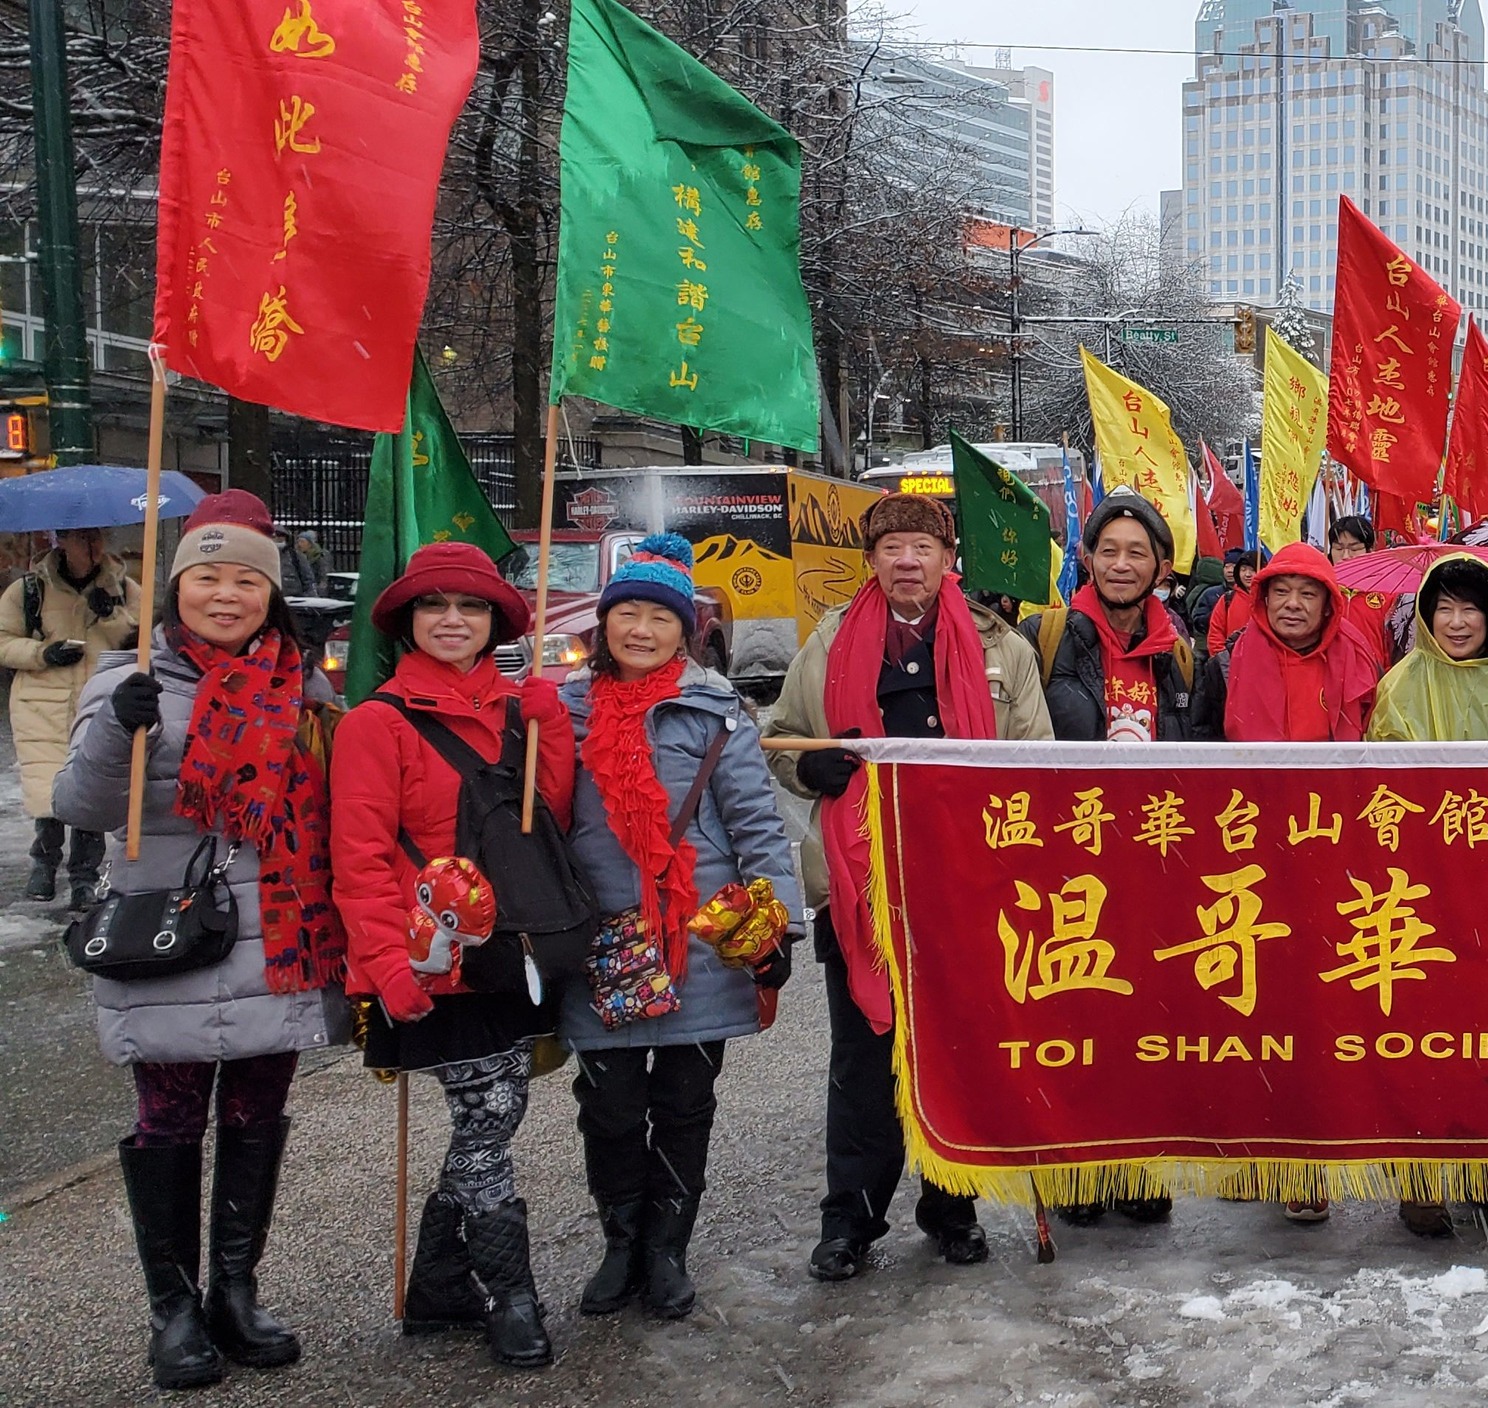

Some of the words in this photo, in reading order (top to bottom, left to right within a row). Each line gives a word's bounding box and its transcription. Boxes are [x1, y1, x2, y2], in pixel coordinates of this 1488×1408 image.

[1125, 330, 1160, 342] Beatty
[1164, 331, 1176, 341] St
[900, 477, 954, 493] SPECIAL
[671, 504, 783, 514] HARLEY-DAVIDSON
[998, 1038, 1094, 1069] TOI
[1135, 1034, 1295, 1062] SHAN
